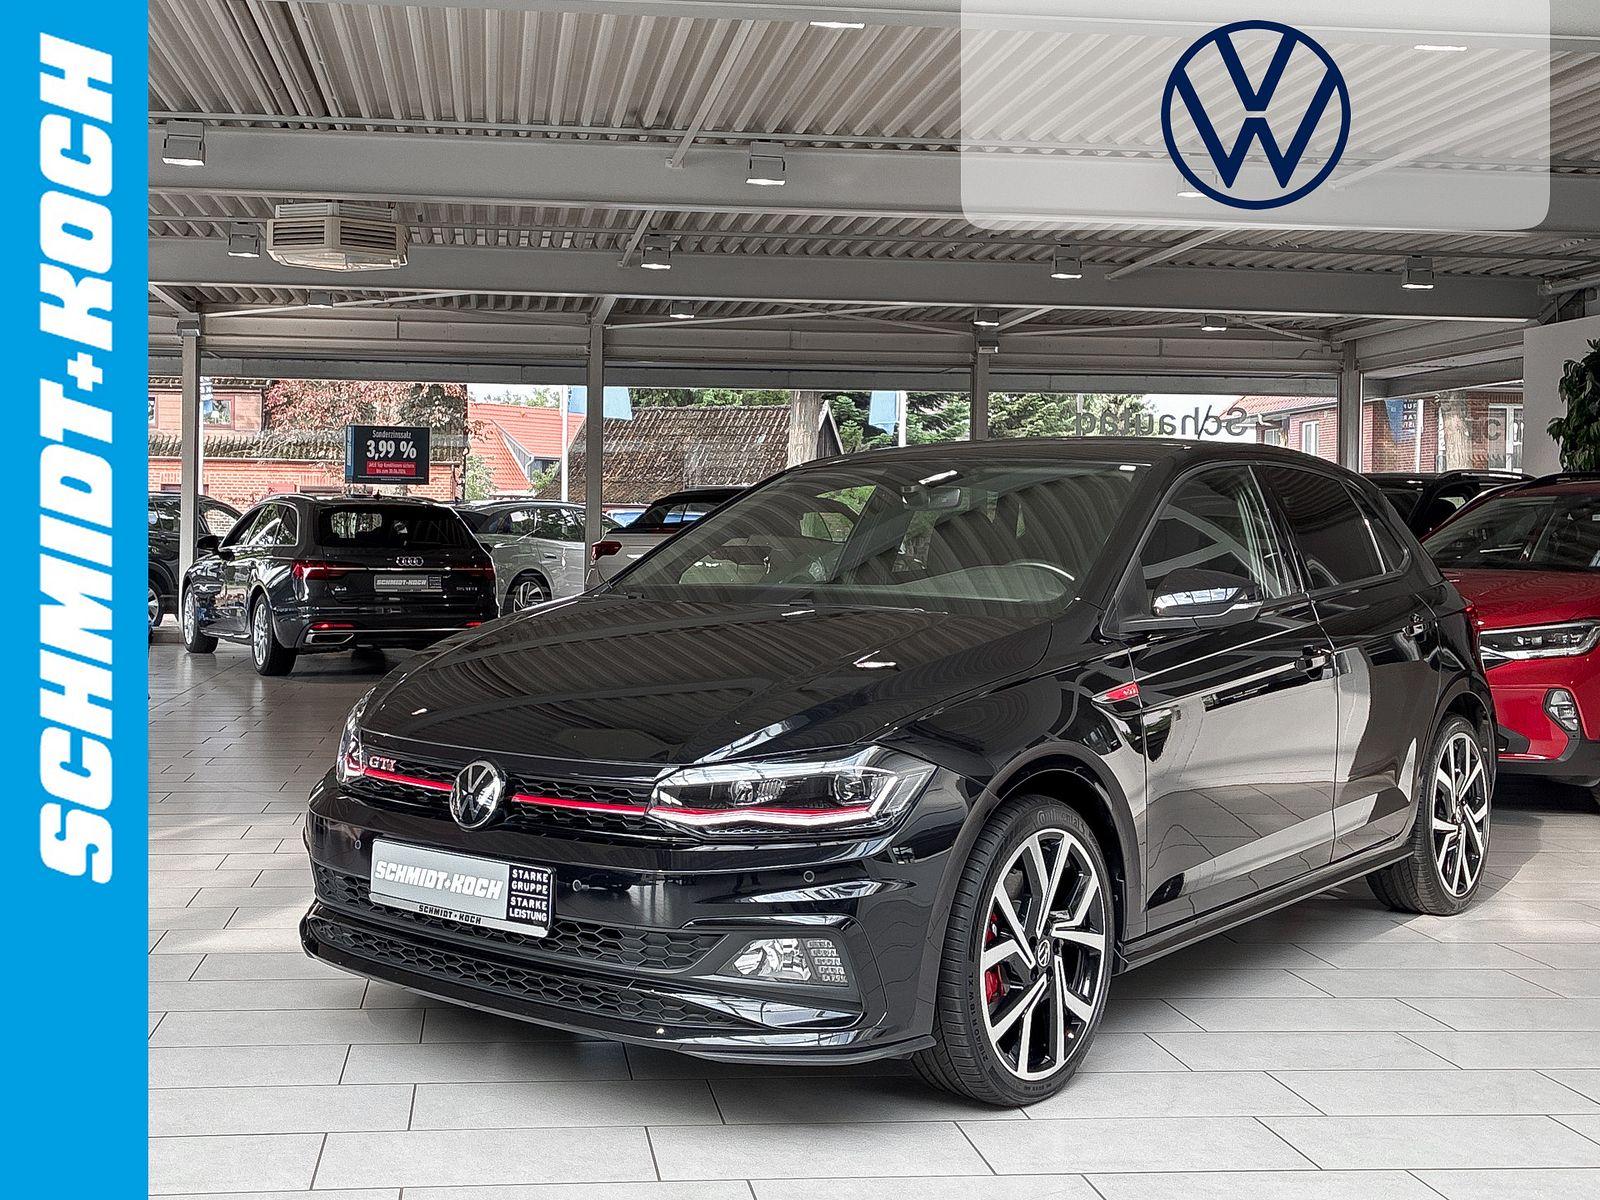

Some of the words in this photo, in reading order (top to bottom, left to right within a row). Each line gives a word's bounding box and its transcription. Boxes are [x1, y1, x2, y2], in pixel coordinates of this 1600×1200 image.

[372, 429, 412, 439] Sonderzinssatz
[366, 440, 396, 460] 3,99
[399, 440, 417, 459] %
[369, 756, 397, 772] GTI
[512, 868, 549, 883] STARKE
[511, 881, 548, 895] GRUPPE
[510, 896, 548, 911] STARKE
[509, 908, 548, 922] LEISTUNG
